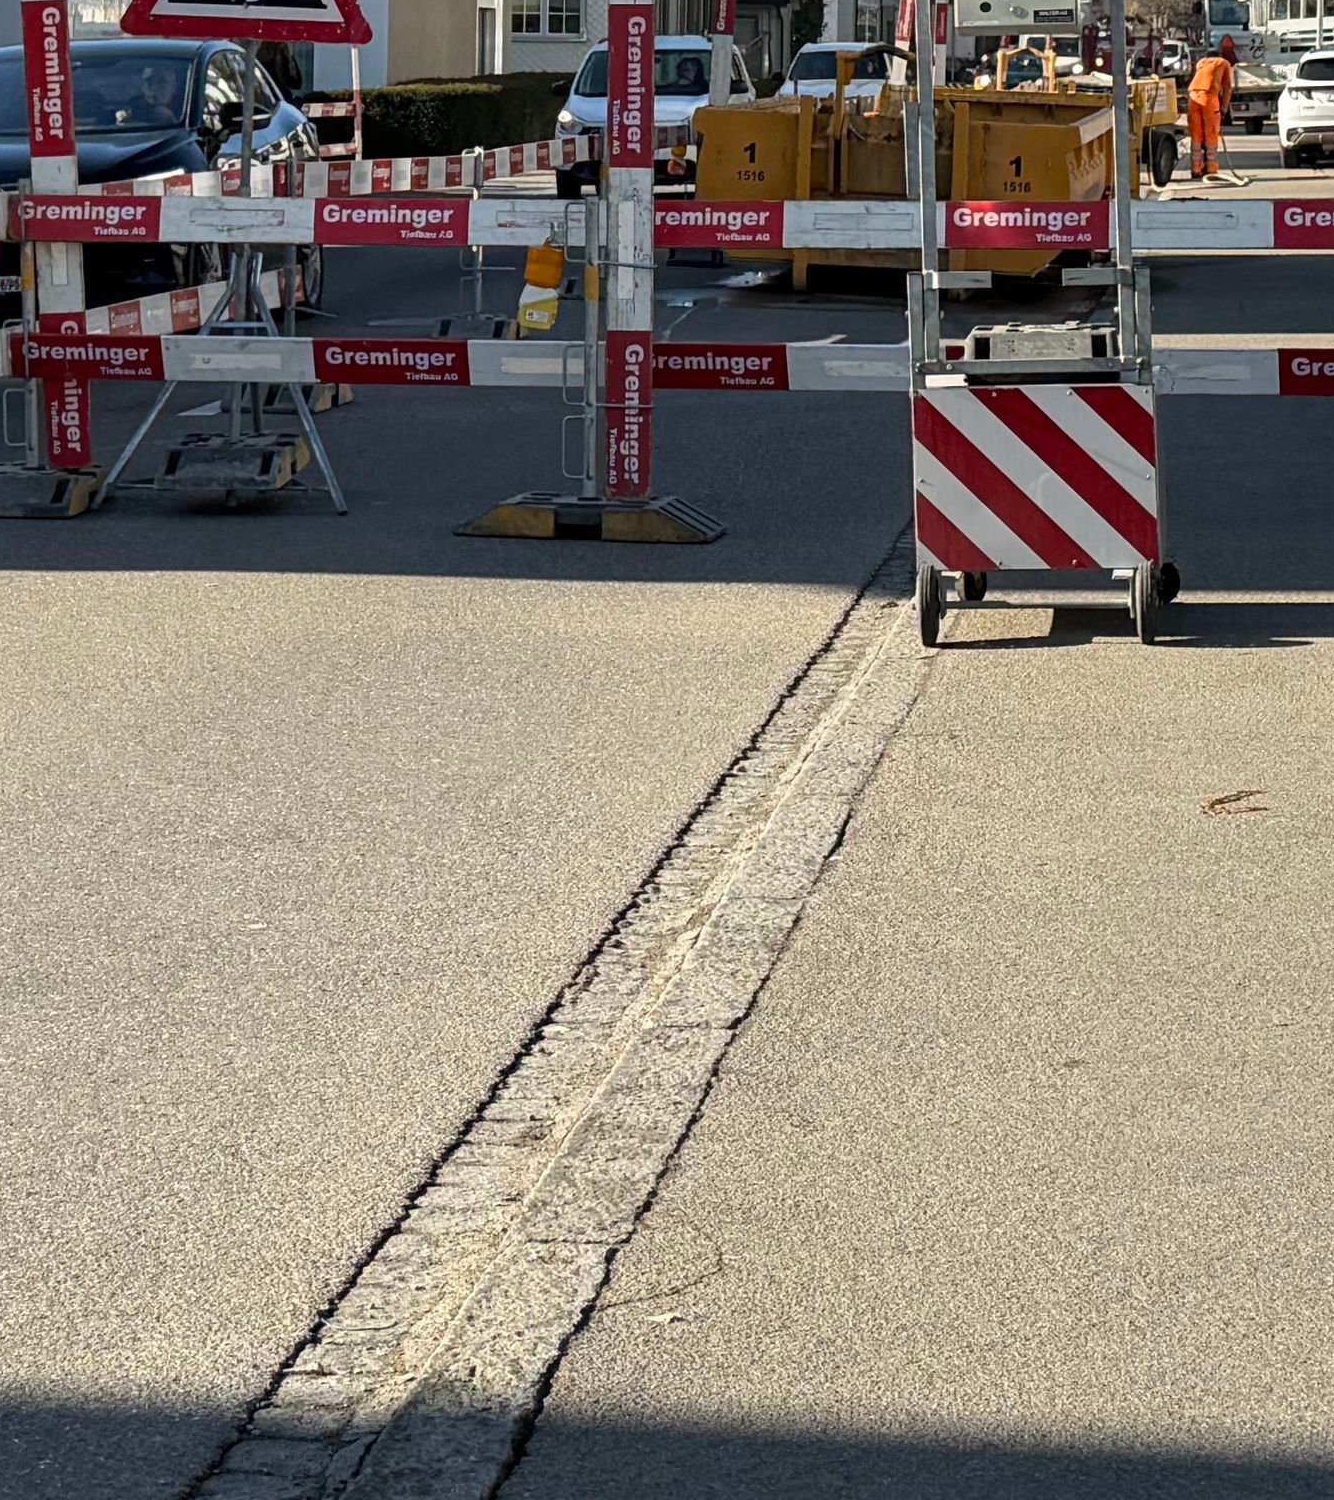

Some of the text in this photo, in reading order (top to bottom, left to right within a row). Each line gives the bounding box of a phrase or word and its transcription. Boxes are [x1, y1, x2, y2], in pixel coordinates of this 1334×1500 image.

[42, 6, 65, 140] Greminger
[623, 16, 647, 154] Greminger
[744, 142, 757, 164] 1
[737, 170, 765, 182] 1516
[1009, 156, 1023, 178] 1
[1003, 182, 1031, 194] 1516
[17, 201, 147, 224] Greminger
[323, 204, 453, 228] Greminger
[655, 208, 769, 230] reminger
[953, 208, 1091, 231] Greminger
[23, 342, 149, 365] Greminger
[325, 346, 456, 370] Greminger
[652, 352, 773, 375] reminger
[619, 344, 644, 484] Greminger
